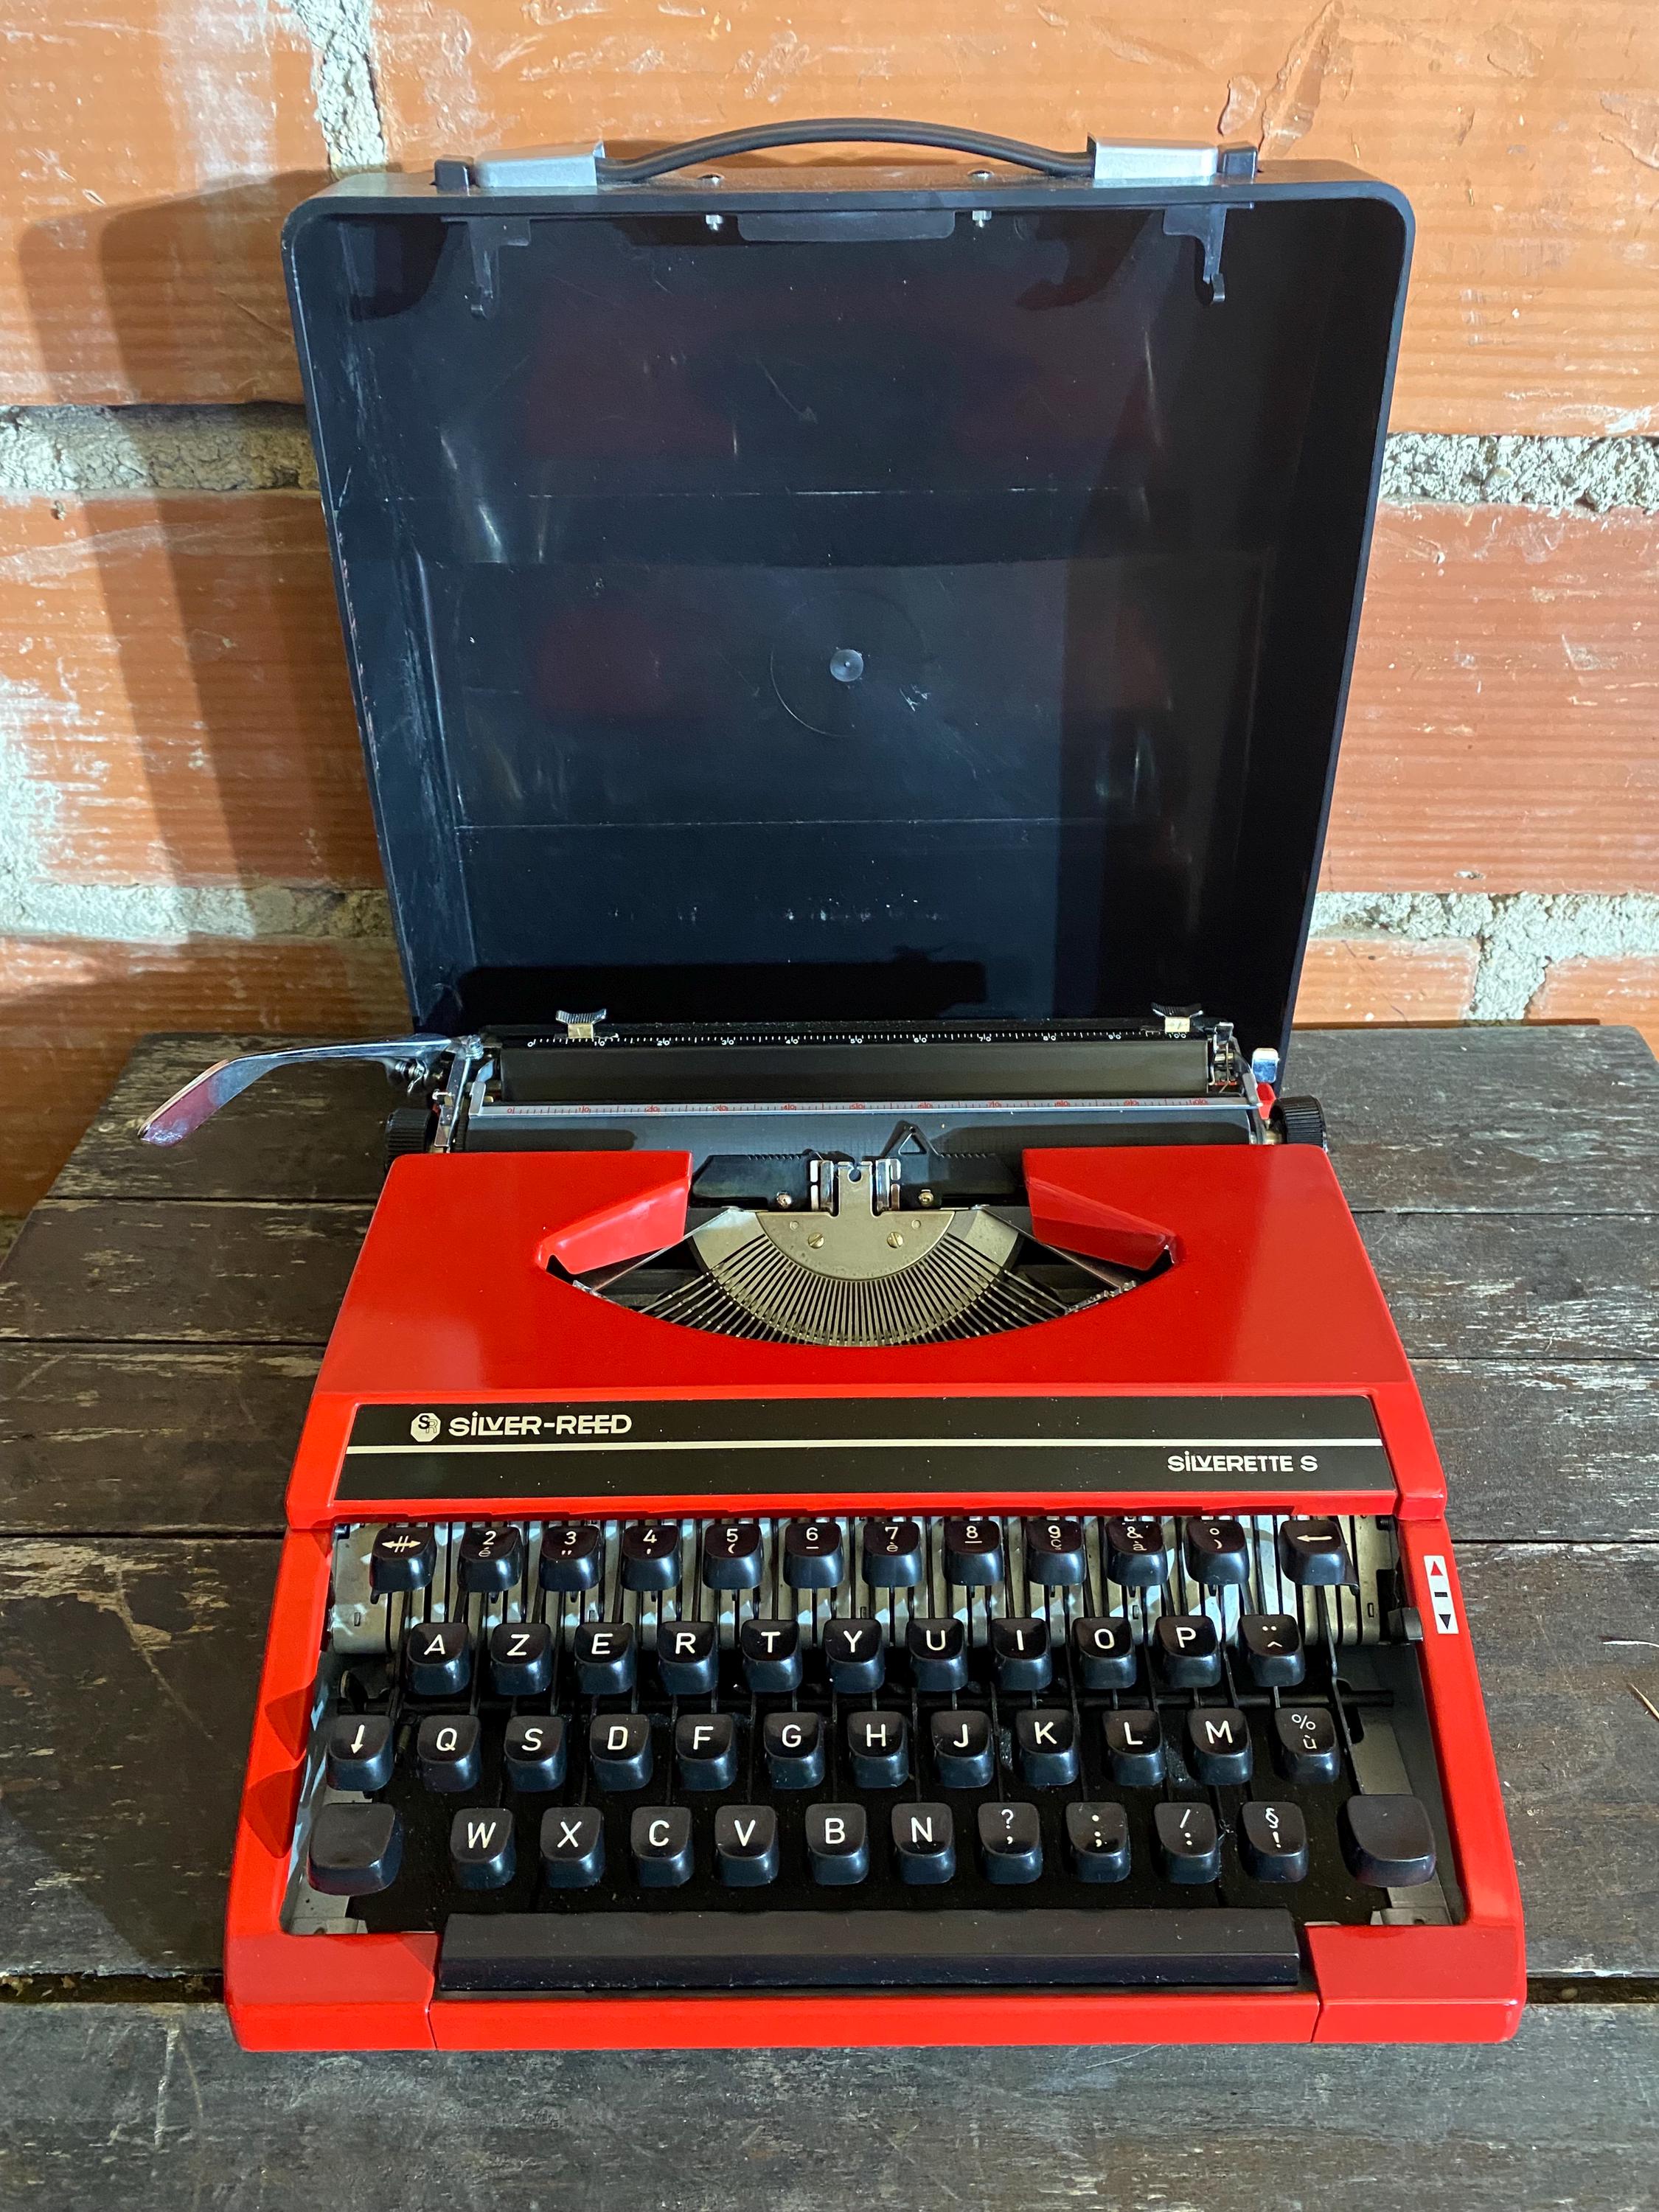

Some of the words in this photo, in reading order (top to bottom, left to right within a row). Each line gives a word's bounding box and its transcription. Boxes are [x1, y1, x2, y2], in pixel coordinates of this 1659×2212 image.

[1300, 1455, 1318, 1472] S
[482, 1530, 497, 1545] 2
[564, 1531, 577, 1545] 3
[643, 1529, 657, 1543] 4
[726, 1528, 738, 1543] 5
[806, 1526, 818, 1541] 6
[885, 1526, 899, 1540] 7
[966, 1526, 978, 1539] 8
[1048, 1525, 1061, 1539] 9
[1127, 1526, 1144, 1539] &
[479, 1547, 491, 1557] é
[423, 1633, 446, 1655] A
[507, 1633, 531, 1656] Z
[591, 1632, 613, 1655] E
[675, 1632, 696, 1655] R
[760, 1631, 782, 1653] T
[843, 1630, 863, 1653] Y
[925, 1629, 946, 1651] U
[1016, 1629, 1024, 1651] I
[1093, 1628, 1115, 1649] O
[1175, 1627, 1197, 1649] P
[1034, 1721, 1057, 1745] K
[1124, 1721, 1144, 1745] L
[1205, 1719, 1234, 1745] M
[1291, 1714, 1316, 1731] %
[436, 1727, 458, 1751] Q
[521, 1728, 543, 1751] S
[607, 1725, 628, 1750] D
[692, 1725, 714, 1750] F
[782, 1724, 801, 1748] G
[866, 1723, 886, 1747] H
[953, 1723, 969, 1747] J
[1303, 1734, 1317, 1750] ù
[911, 1816, 933, 1843] N
[1001, 1809, 1014, 1829] ?
[1265, 1808, 1279, 1829] §
[467, 1821, 497, 1849] W
[557, 1820, 582, 1848] X
[649, 1820, 670, 1847] C
[734, 1819, 757, 1847] V
[824, 1818, 846, 1844] B
[1272, 1831, 1282, 1848] !
